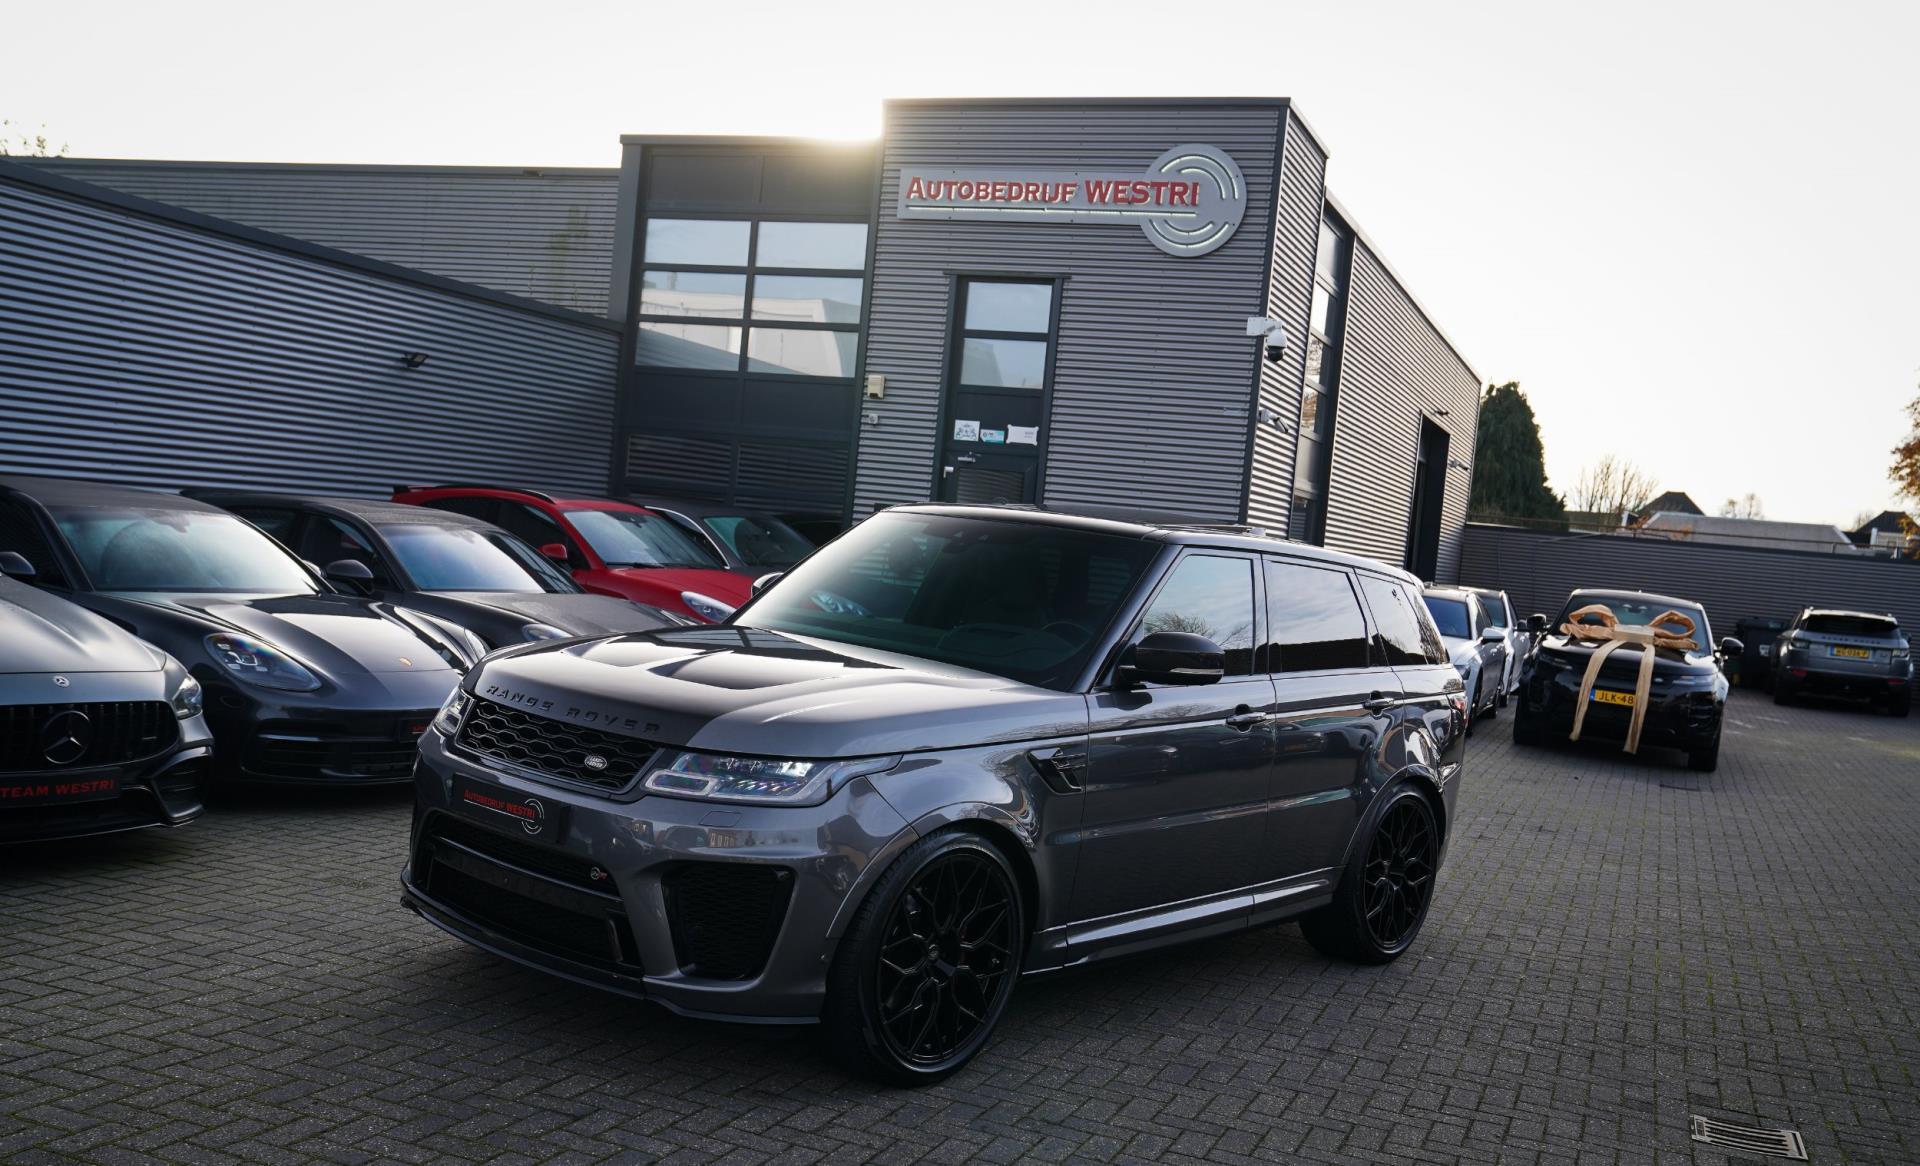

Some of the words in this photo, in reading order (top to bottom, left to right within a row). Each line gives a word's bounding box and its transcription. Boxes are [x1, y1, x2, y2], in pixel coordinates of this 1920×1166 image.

[906, 176, 1078, 204] AUTOBEDRIJF
[1085, 179, 1200, 206] WESTRI
[486, 685, 555, 710] RANGE
[565, 707, 661, 733] ROVER
[0, 785, 49, 799] TEAM
[55, 779, 115, 796] WESTRI
[505, 803, 536, 819] WESTRI
